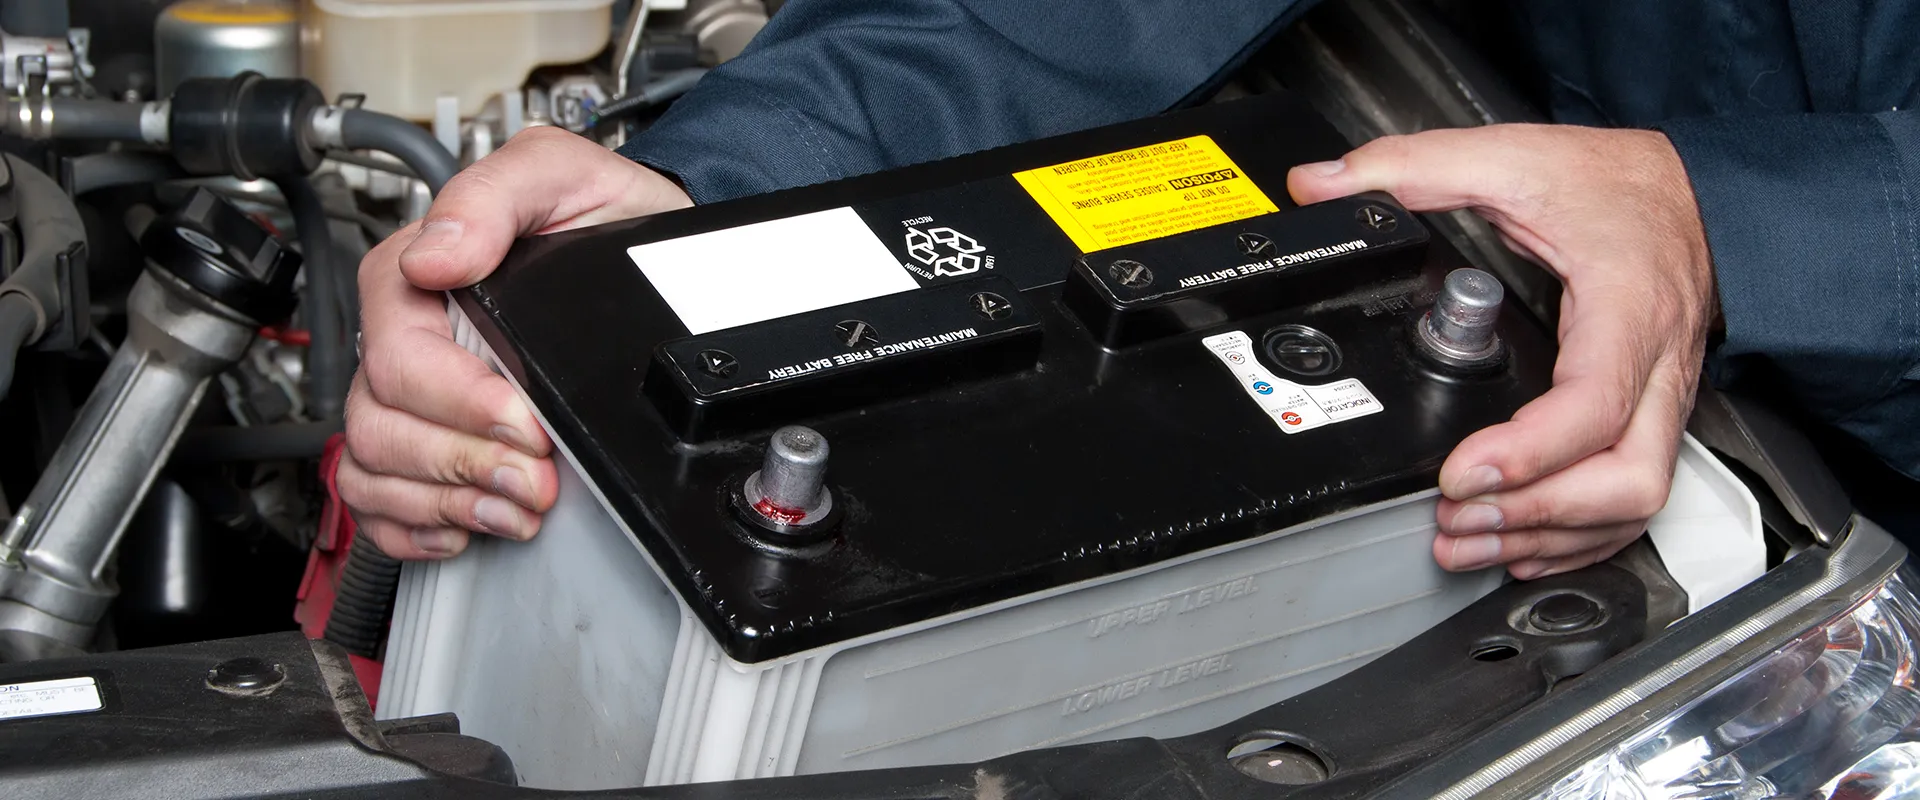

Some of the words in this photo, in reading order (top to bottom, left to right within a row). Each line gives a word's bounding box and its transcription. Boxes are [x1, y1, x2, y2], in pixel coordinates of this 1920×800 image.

[1138, 150, 1149, 158] OF
[1150, 146, 1167, 156] OUT
[1169, 142, 1189, 152] KEEP
[1096, 158, 1108, 166] OF
[1107, 152, 1137, 164] REACH
[1053, 161, 1095, 175] CHILDREN
[1171, 172, 1223, 188] POISON
[1101, 191, 1134, 203] SEVERE
[1133, 184, 1168, 196] CAUSES
[1184, 192, 1198, 201] TIP
[1198, 189, 1216, 198] NOT
[1216, 186, 1230, 194] DO
[1072, 198, 1102, 209] BURNS
[901, 215, 934, 227] RECYCLE
[1275, 239, 1368, 266] MAINTENANCE
[984, 255, 995, 270] LEAD
[1237, 258, 1276, 275] FREE
[904, 262, 935, 280] RETURN
[1179, 268, 1238, 288] BATTERY
[873, 328, 978, 357] MAINTENANCE
[833, 351, 873, 367] FREE
[767, 360, 833, 380] BATTERY
[1325, 397, 1372, 413] INDICATOR
[1087, 600, 1171, 638] UPPER
[1178, 576, 1259, 615] LEVEL
[1061, 676, 1151, 717] LOWER
[1159, 654, 1233, 689] LEVEL
